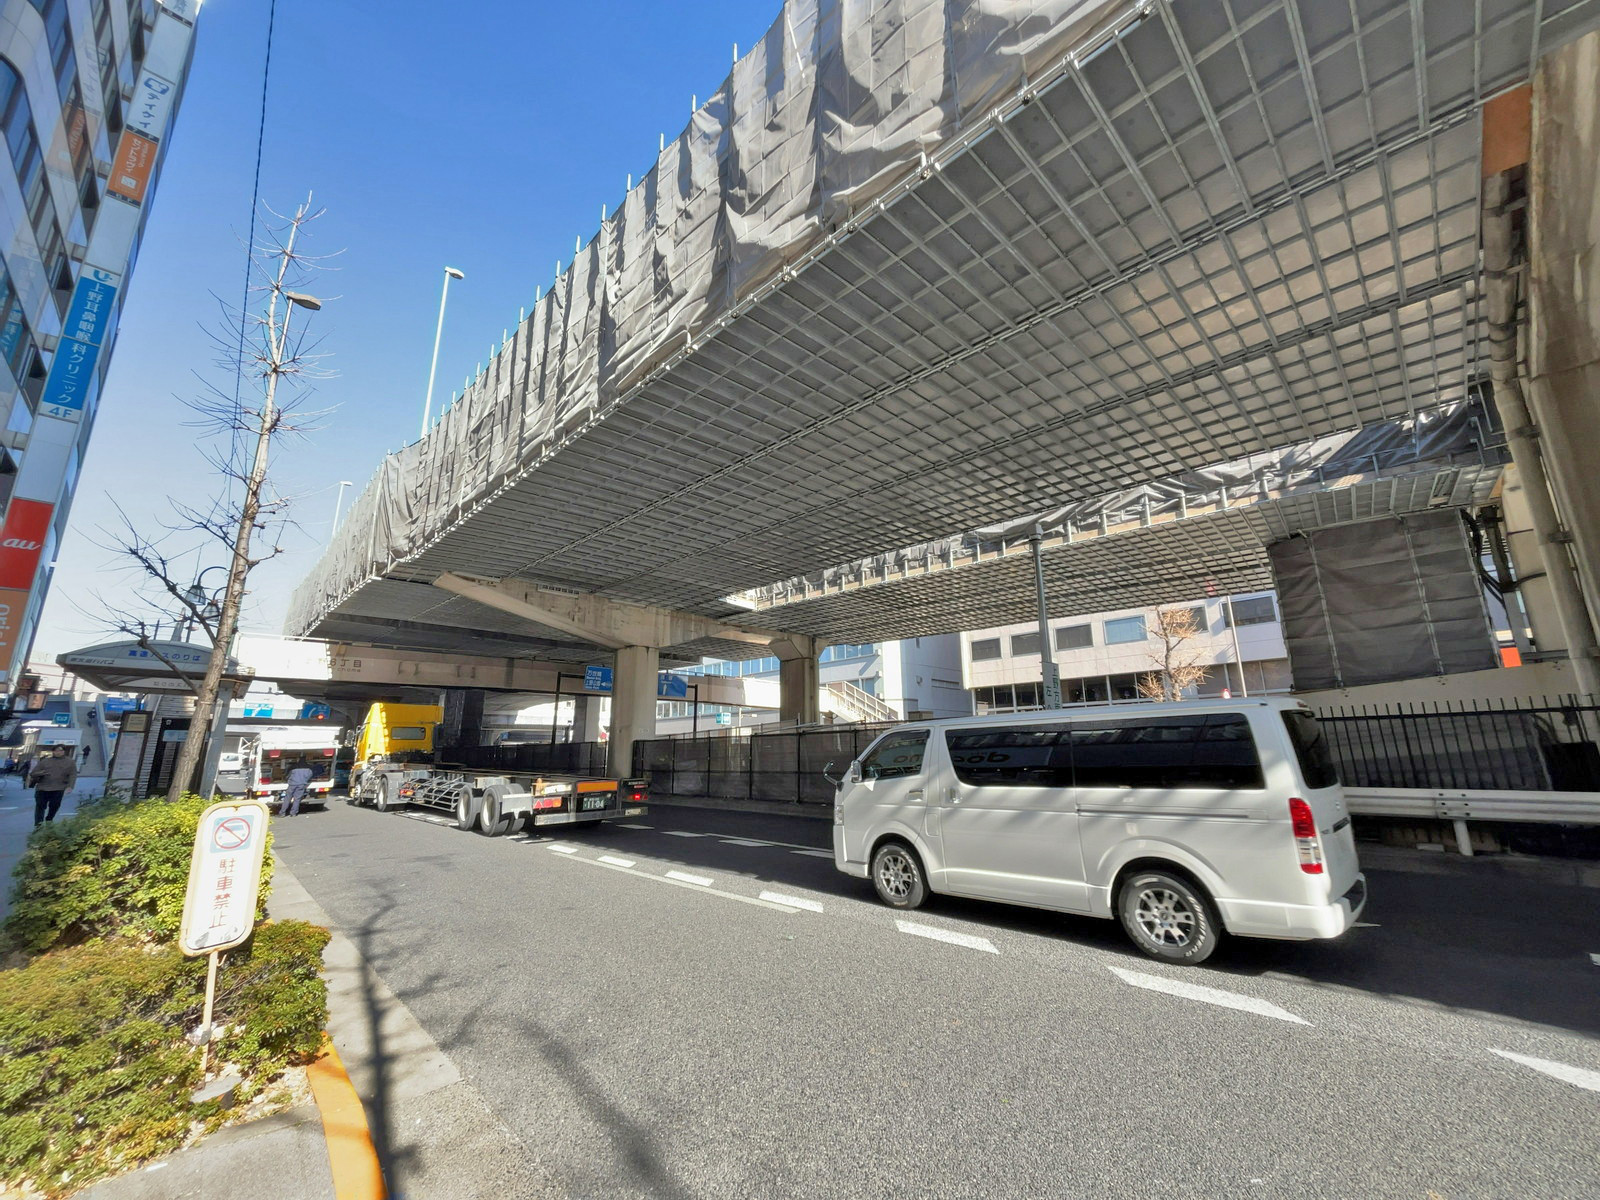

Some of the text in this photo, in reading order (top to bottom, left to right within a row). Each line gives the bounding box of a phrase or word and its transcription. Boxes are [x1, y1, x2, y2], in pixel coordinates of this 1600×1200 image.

[48, 406, 73, 419] 4F
[2, 538, 41, 550] au
[208, 858, 235, 929] 駐車禁止
